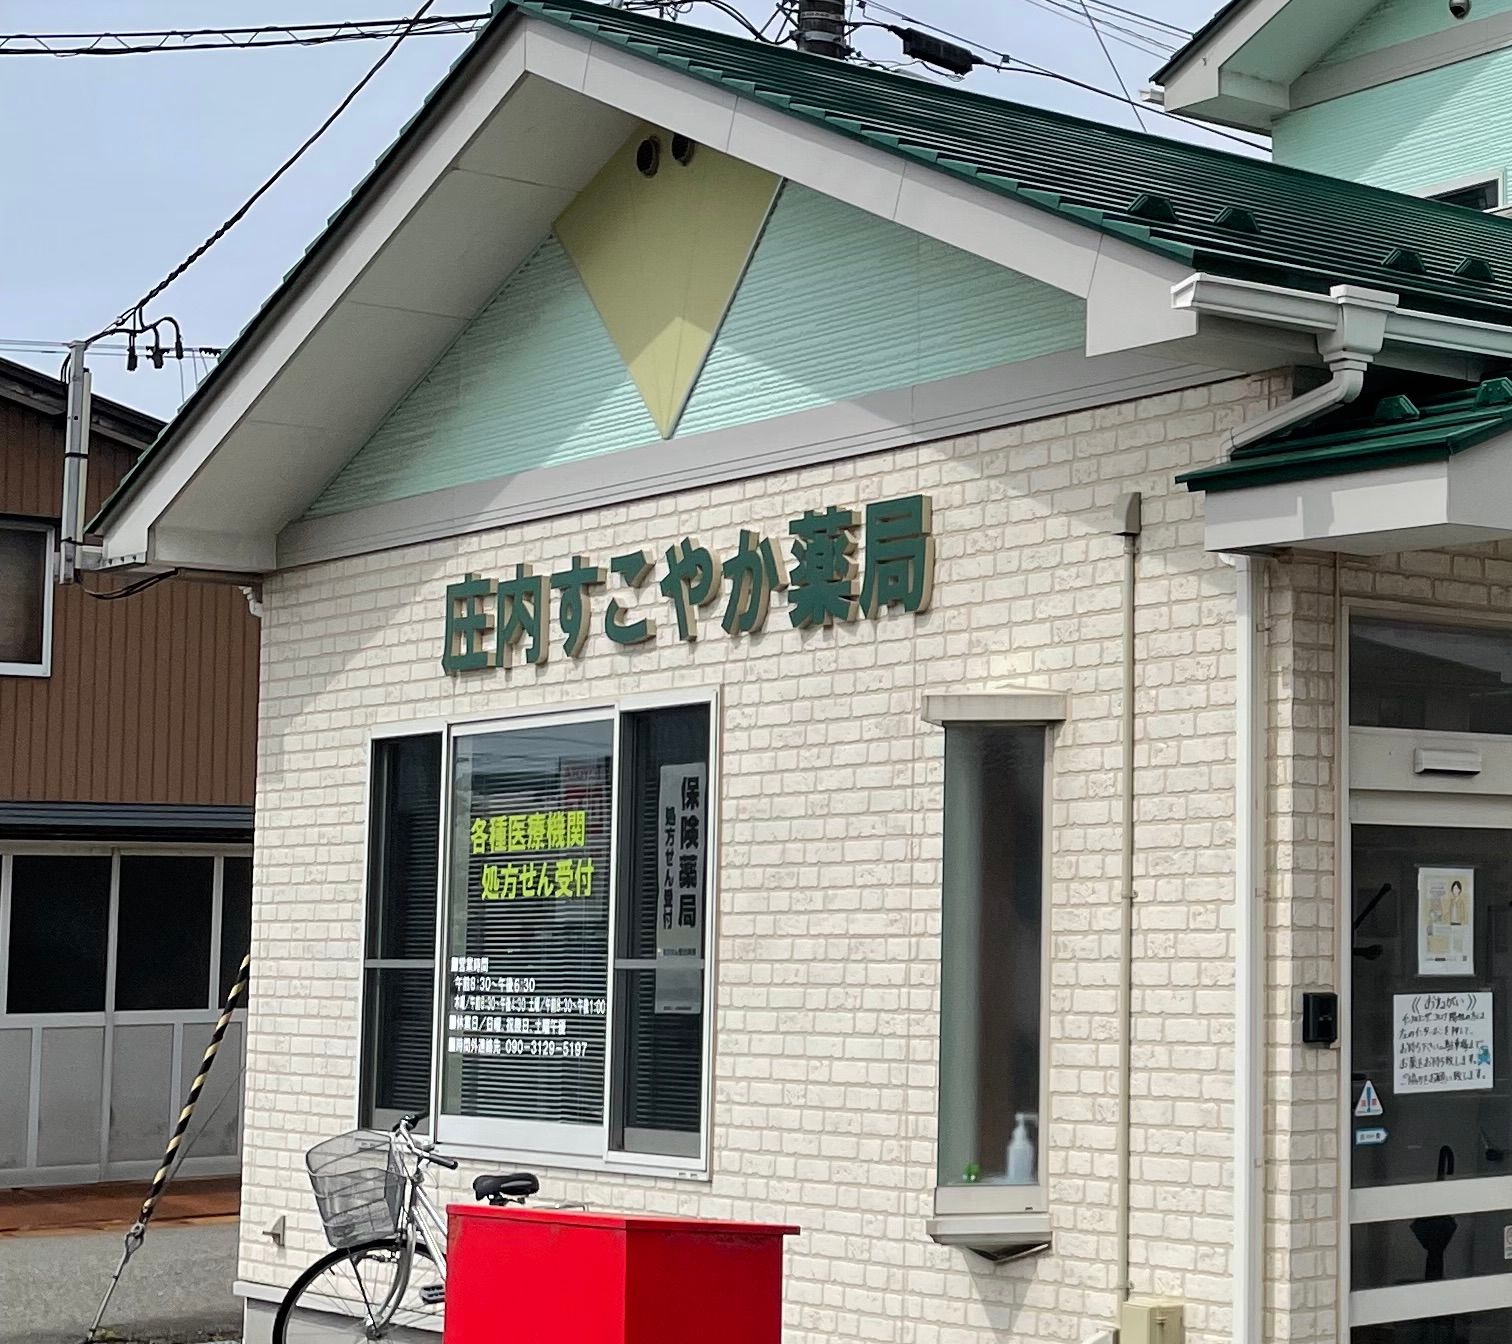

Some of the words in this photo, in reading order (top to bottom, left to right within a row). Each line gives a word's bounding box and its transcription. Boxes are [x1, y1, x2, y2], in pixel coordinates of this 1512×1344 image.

[441, 494, 937, 677] 庄内すこやか薬局
[470, 810, 586, 855] 各種医療機関
[481, 857, 595, 901] 処方せん受付
[678, 776, 700, 929] 保険薬局
